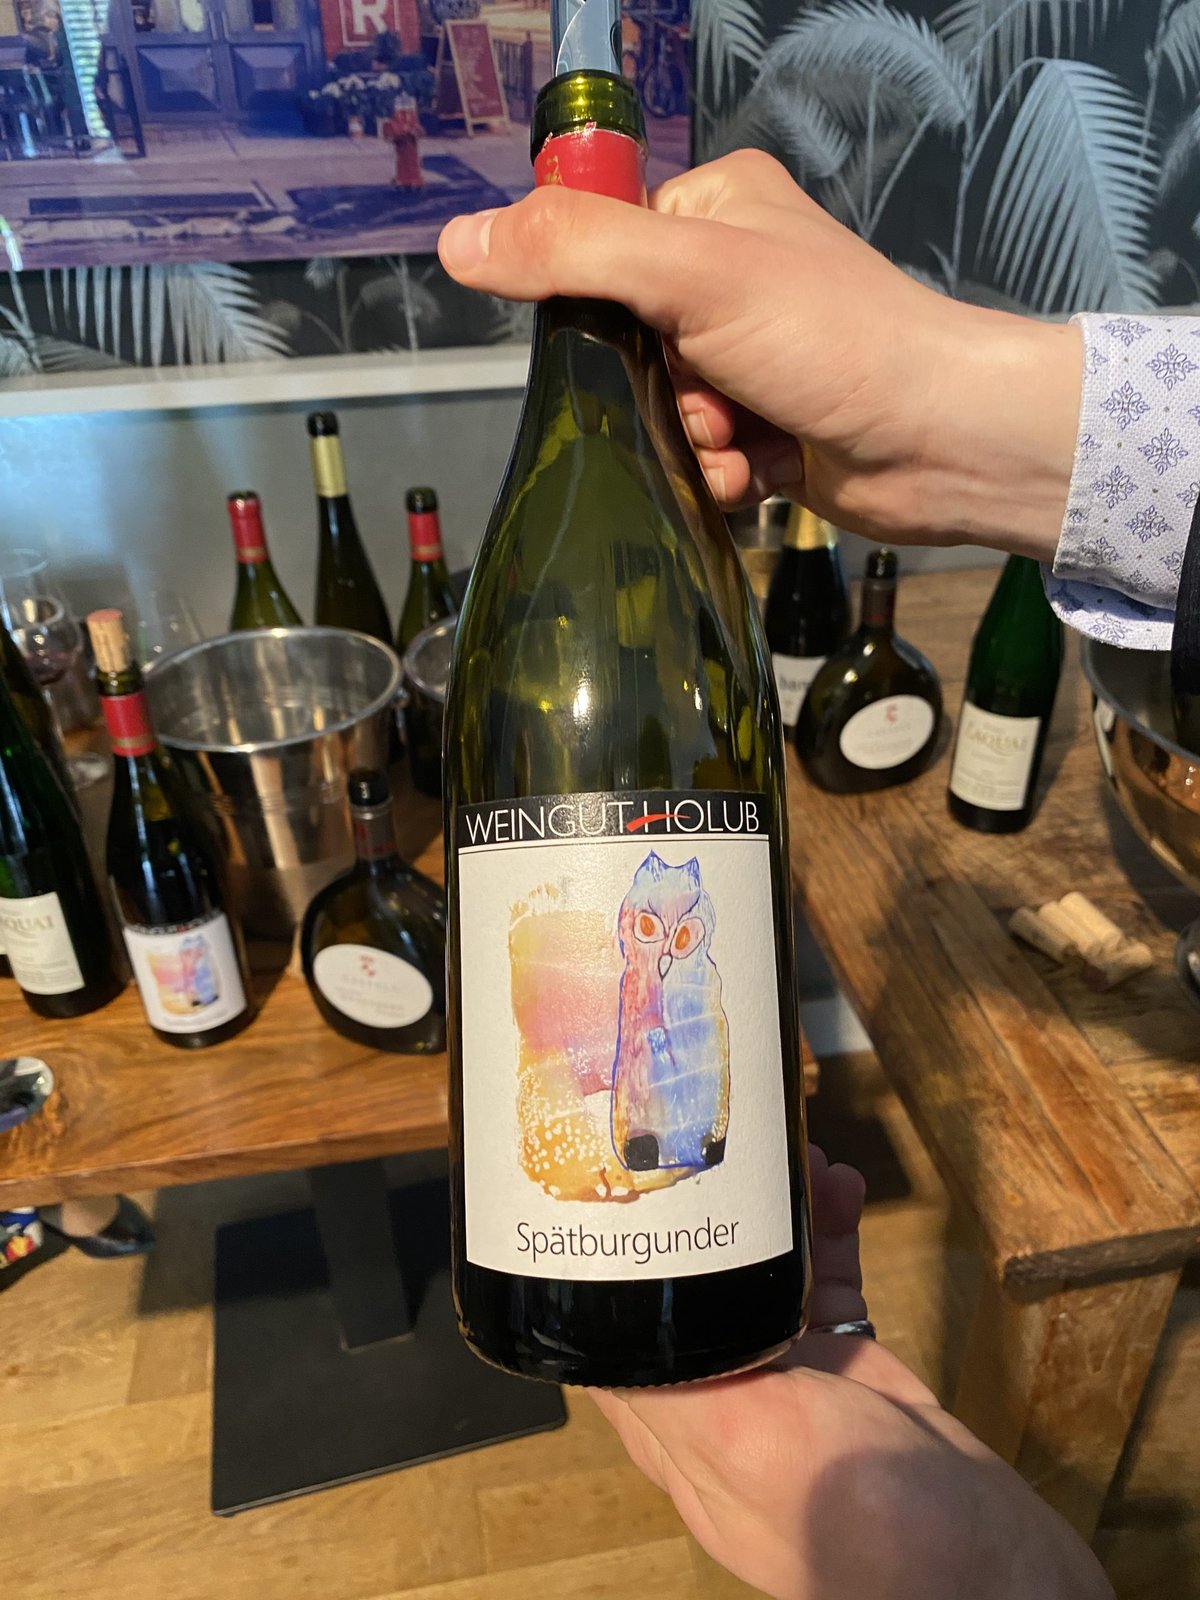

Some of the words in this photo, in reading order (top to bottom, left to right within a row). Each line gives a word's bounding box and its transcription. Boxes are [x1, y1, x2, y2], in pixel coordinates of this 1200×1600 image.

[352, 0, 388, 35] R
[465, 800, 634, 844] WEINGUT
[641, 799, 760, 833] HOLUB
[516, 1216, 740, 1265] Spätburgunder
